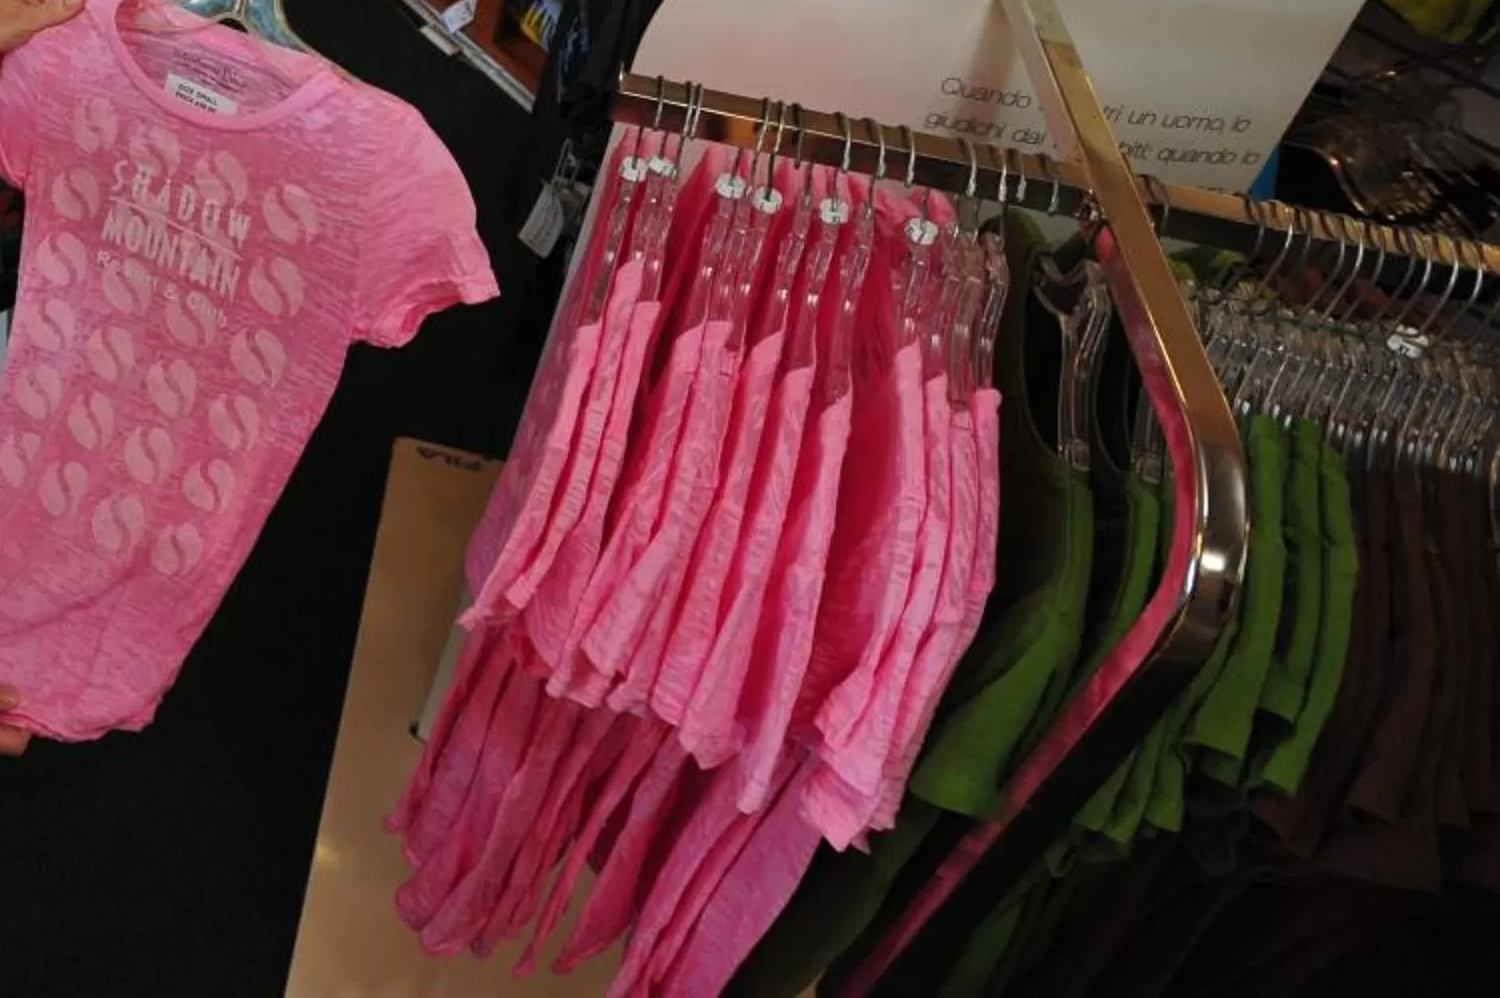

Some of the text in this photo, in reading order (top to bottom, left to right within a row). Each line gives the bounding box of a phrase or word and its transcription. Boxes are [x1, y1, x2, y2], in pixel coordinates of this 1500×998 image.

[941, 76, 1032, 109] Quando
[1128, 110, 1157, 127] un
[1157, 146, 1237, 165] quando
[111, 159, 251, 250] SHADOW
[103, 207, 241, 302] MOUNTAIN
